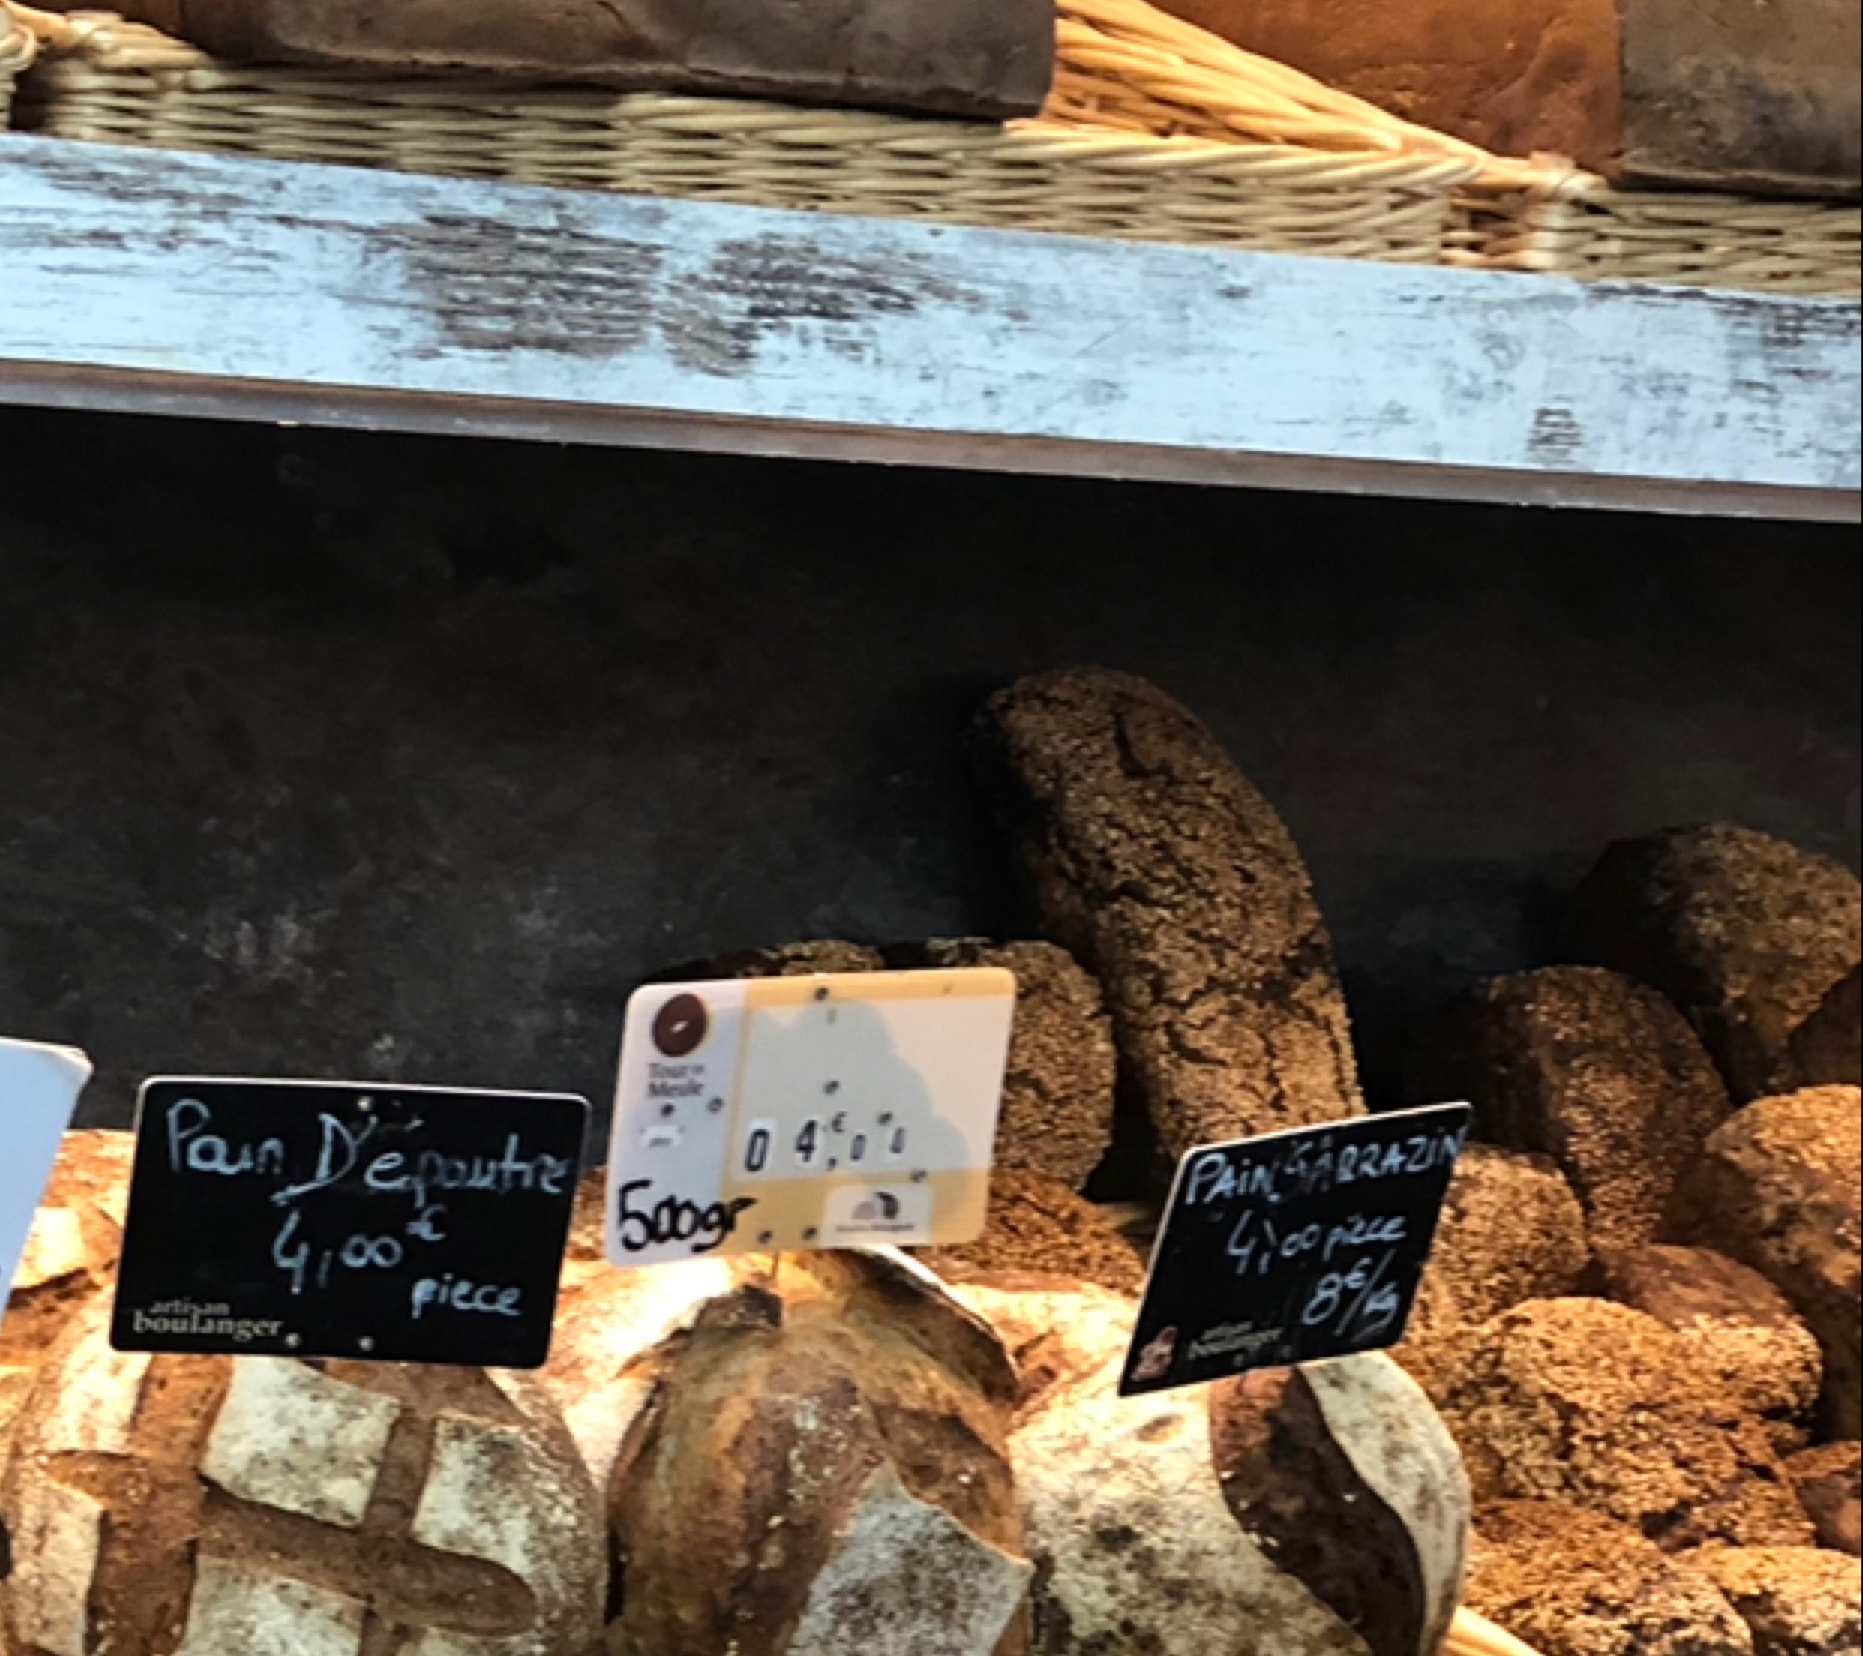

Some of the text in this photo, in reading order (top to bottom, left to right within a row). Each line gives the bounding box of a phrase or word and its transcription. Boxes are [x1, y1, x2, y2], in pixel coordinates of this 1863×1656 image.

[166, 1097, 285, 1175] Pain
[150, 1297, 232, 1319] artisan
[132, 1310, 285, 1342] boulanger
